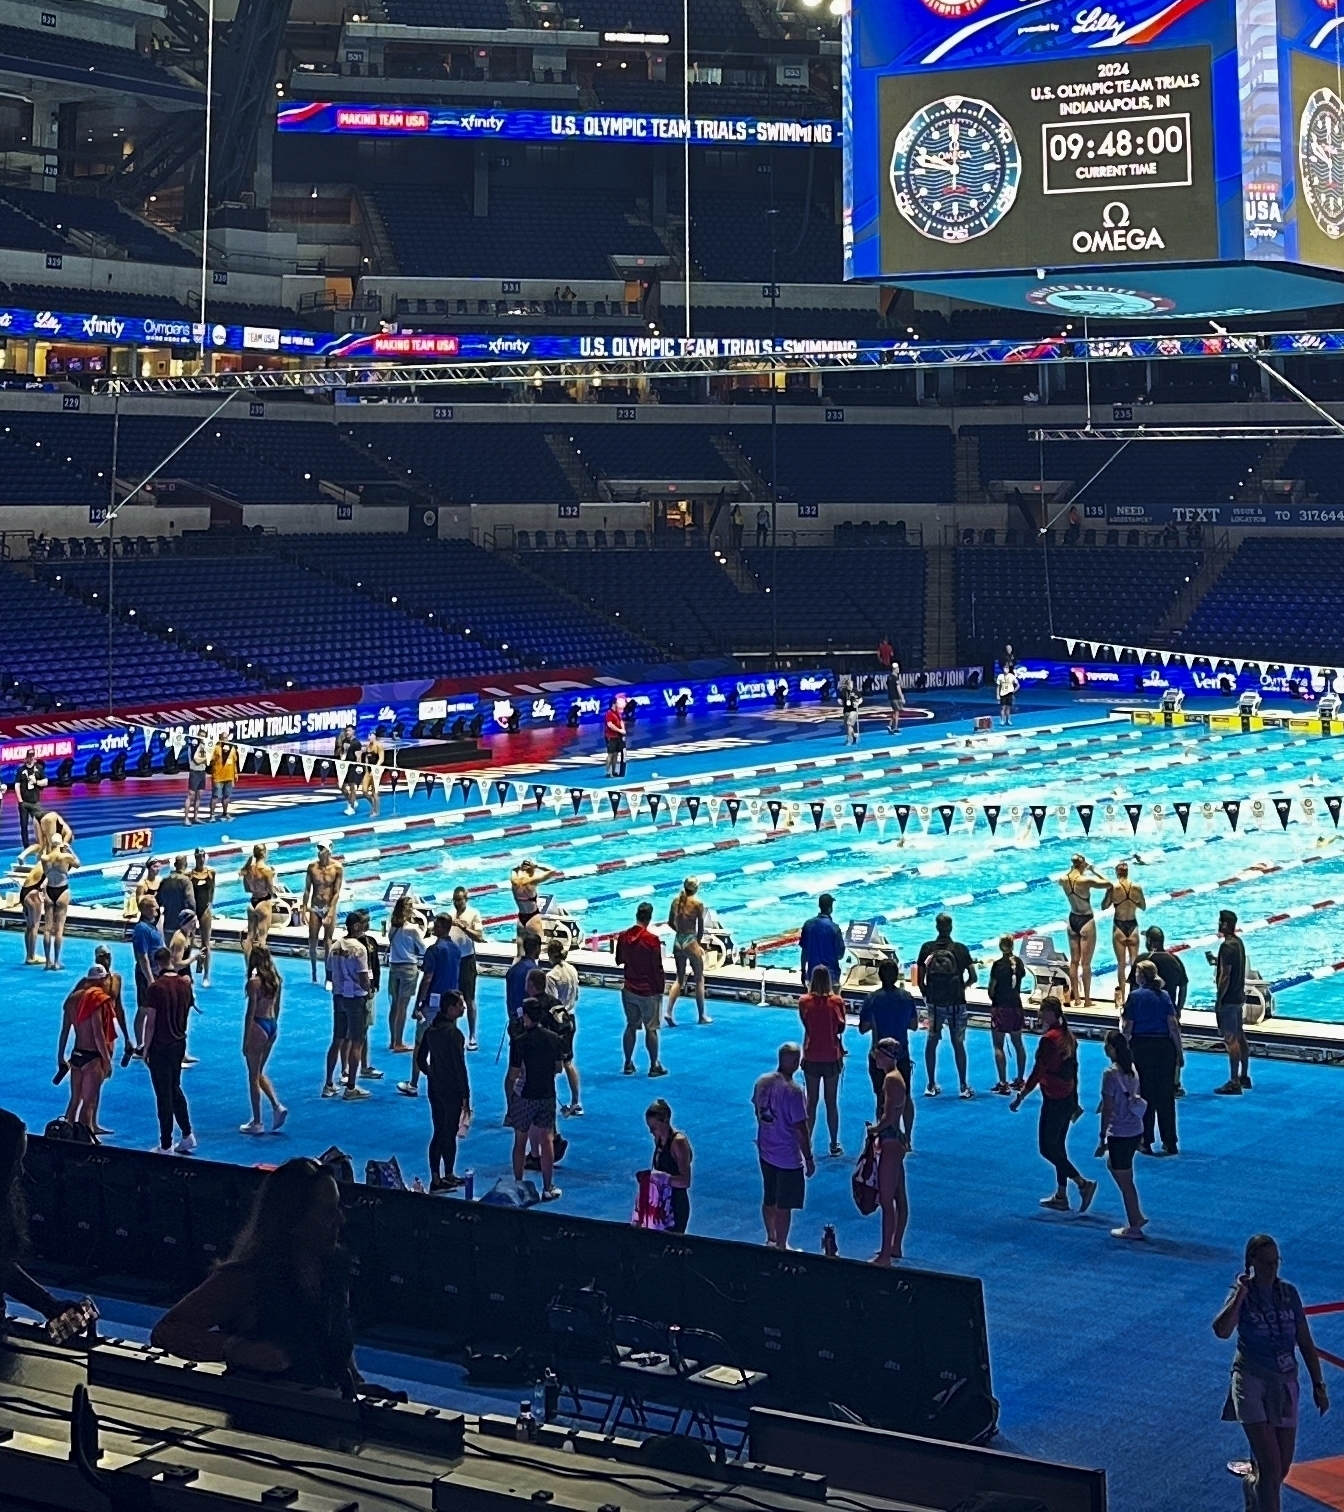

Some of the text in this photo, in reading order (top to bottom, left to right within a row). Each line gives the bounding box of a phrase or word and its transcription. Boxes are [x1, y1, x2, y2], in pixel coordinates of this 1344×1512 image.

[1071, 6, 1125, 37] Lilly
[1097, 62, 1130, 78] 2024
[1030, 72, 1200, 101] U.S. OLYMPIC TEAM TRIALS
[1059, 94, 1171, 117] INDIANAPOLIS, IN
[378, 114, 404, 127] TEAM
[406, 115, 426, 128] USA
[460, 117, 505, 132] xfinity
[550, 115, 581, 135] U.S.
[584, 116, 647, 137] OLYMPIC
[651, 118, 687, 139] TEAM
[1048, 125, 1184, 162] 09:48:00
[1075, 162, 1157, 180] CURRENT TIME
[1244, 201, 1282, 223] USA
[1072, 227, 1166, 253] OMEGA
[33, 311, 62, 335] Lilly
[82, 314, 125, 339] xfinity
[143, 318, 191, 337] Olympians
[375, 338, 410, 351] MAKING
[411, 339, 435, 352] TEAM
[436, 339, 457, 352] USA
[488, 337, 531, 354] xfinity
[580, 337, 609, 357] U.S.
[611, 337, 675, 357] OLYMPIC
[64, 396, 80, 408] 229
[559, 506, 578, 516] 132
[799, 505, 817, 516] 132
[1084, 505, 1104, 516] 135
[1116, 505, 1145, 516] NEED
[1172, 507, 1220, 522] TEXT
[1275, 510, 1291, 521] TO
[1086, 672, 1120, 683] TOYOTA
[200, 700, 291, 723] TRIALS
[236, 718, 264, 740] TEAM
